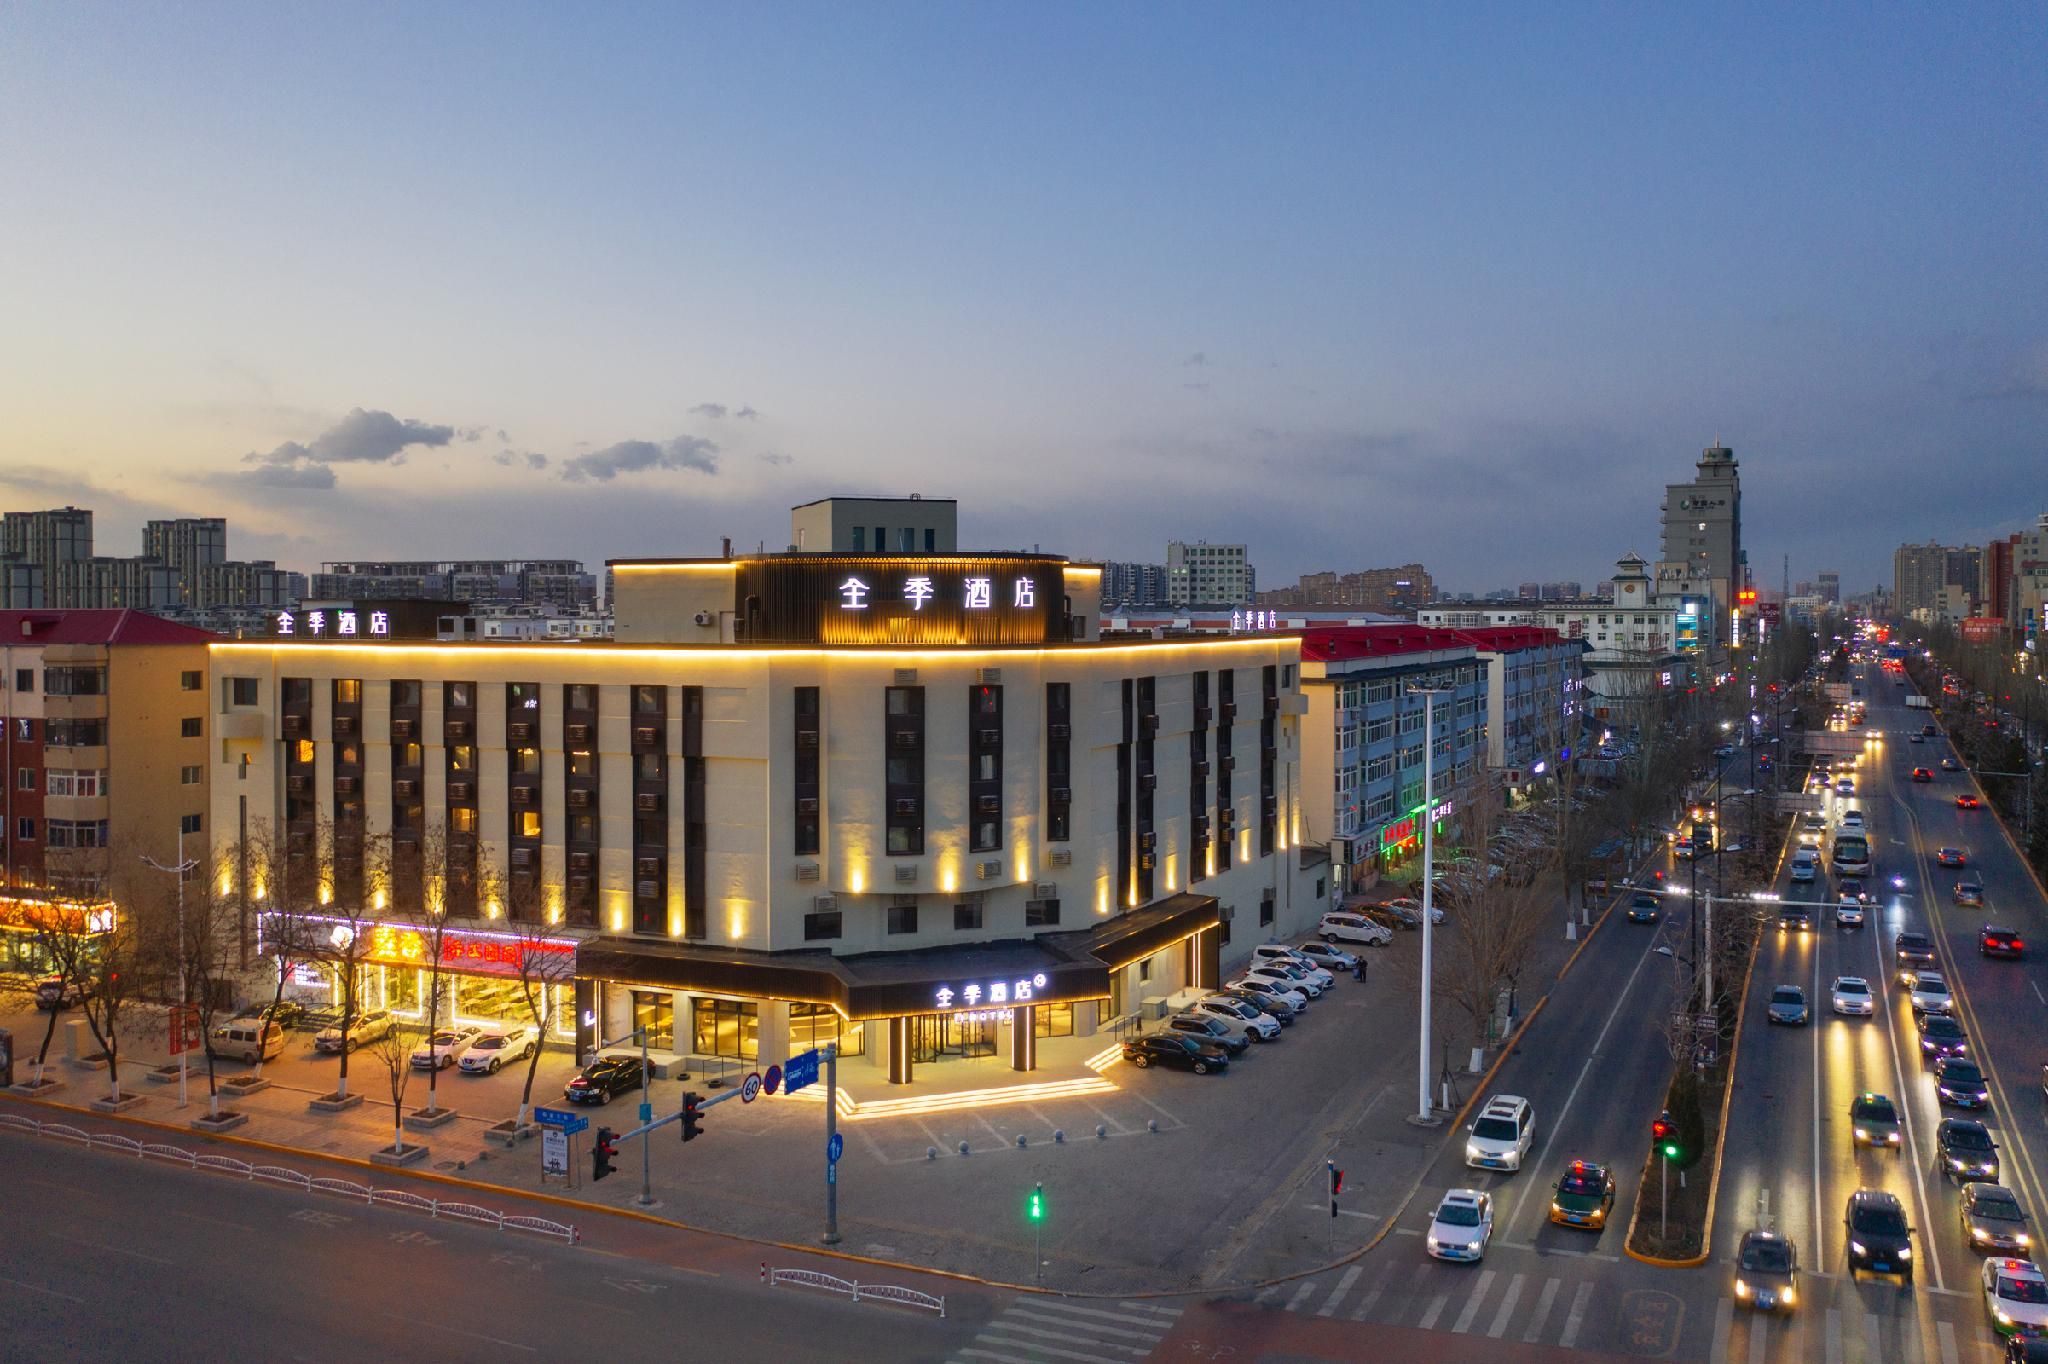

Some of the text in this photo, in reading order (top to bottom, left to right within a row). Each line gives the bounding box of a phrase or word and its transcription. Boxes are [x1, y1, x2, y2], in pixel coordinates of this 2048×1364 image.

[839, 577, 1034, 611] 全季酒店
[277, 611, 387, 634] 全季酒店
[1232, 610, 1276, 630] 全季酒店
[936, 980, 1031, 1007] 全季酒店
[745, 1081, 758, 1096] 60
